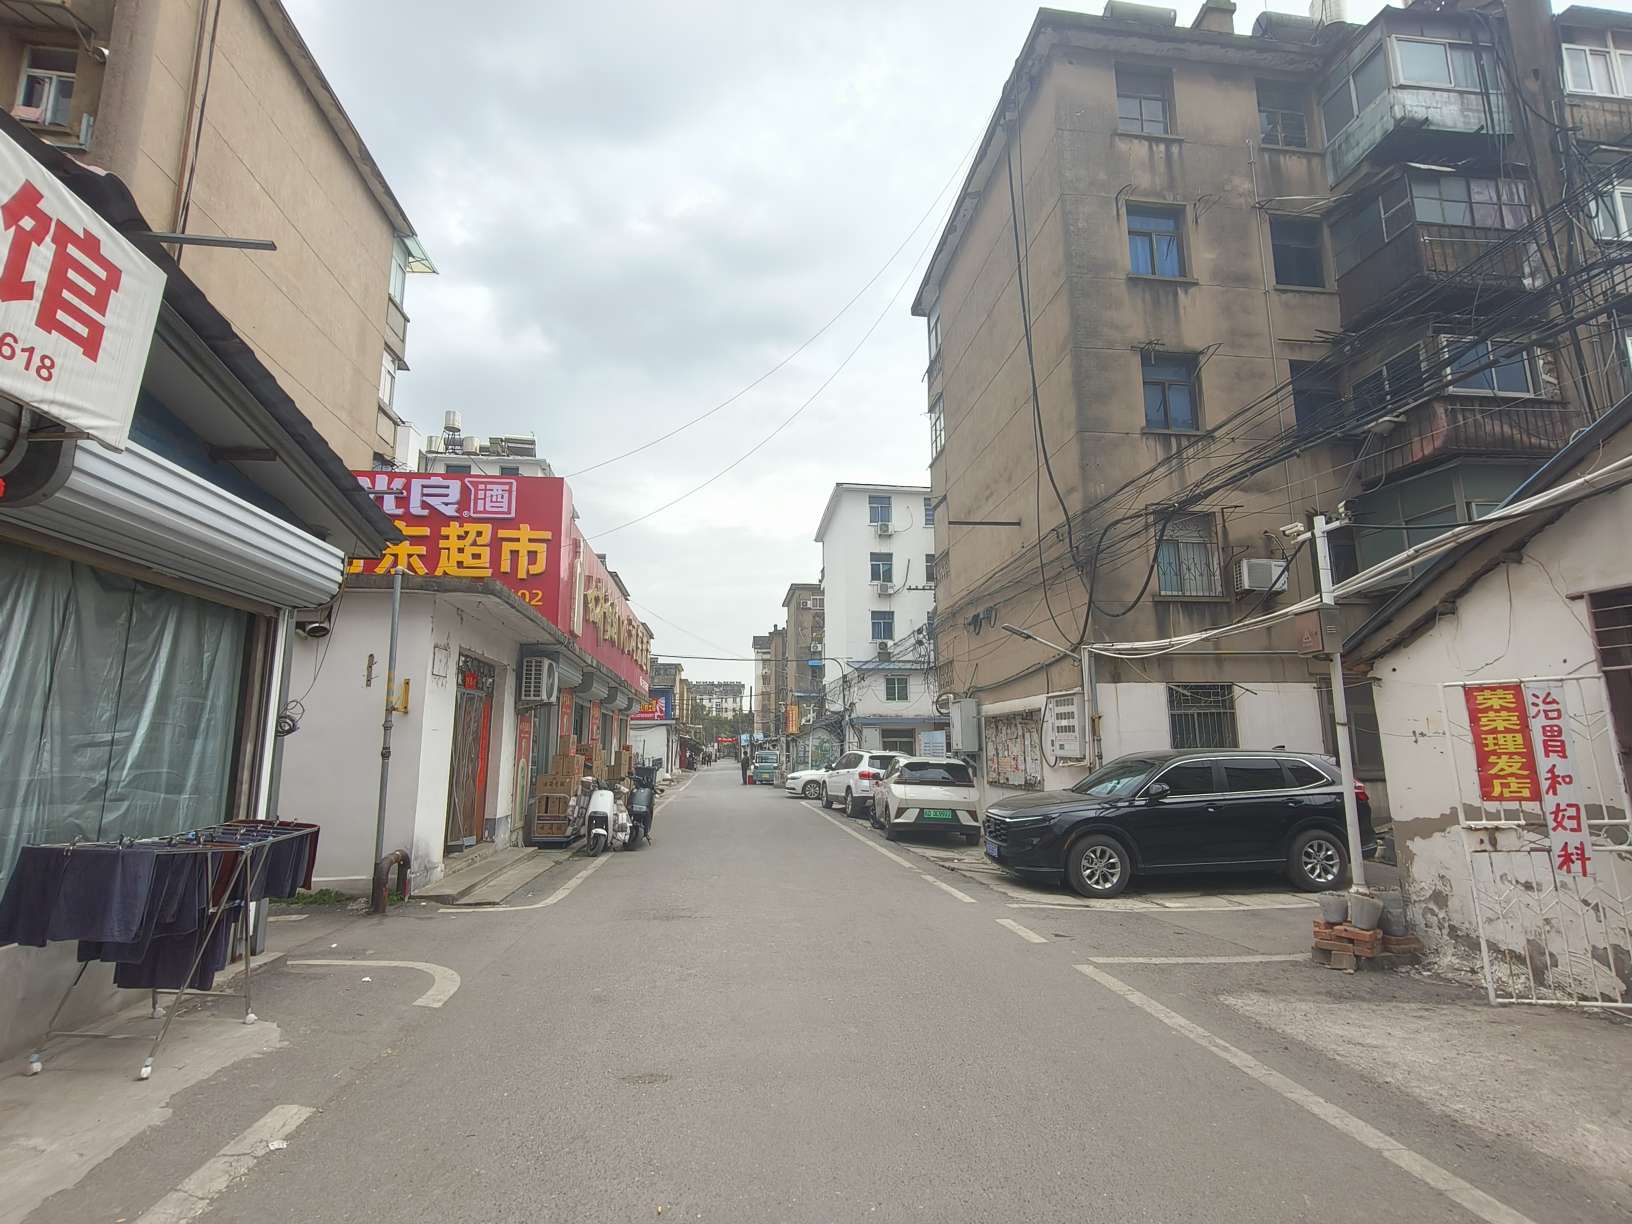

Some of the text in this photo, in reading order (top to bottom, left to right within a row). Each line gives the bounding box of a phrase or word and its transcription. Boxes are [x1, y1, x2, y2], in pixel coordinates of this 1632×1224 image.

[0, 178, 122, 363] 馆
[0, 331, 55, 382] 618
[476, 483, 509, 514] 酒
[347, 520, 553, 580] 东超市
[512, 589, 543, 605] 02
[1471, 688, 1532, 798] 荣荣理发店
[1530, 691, 1592, 878] 治胃和妇科
